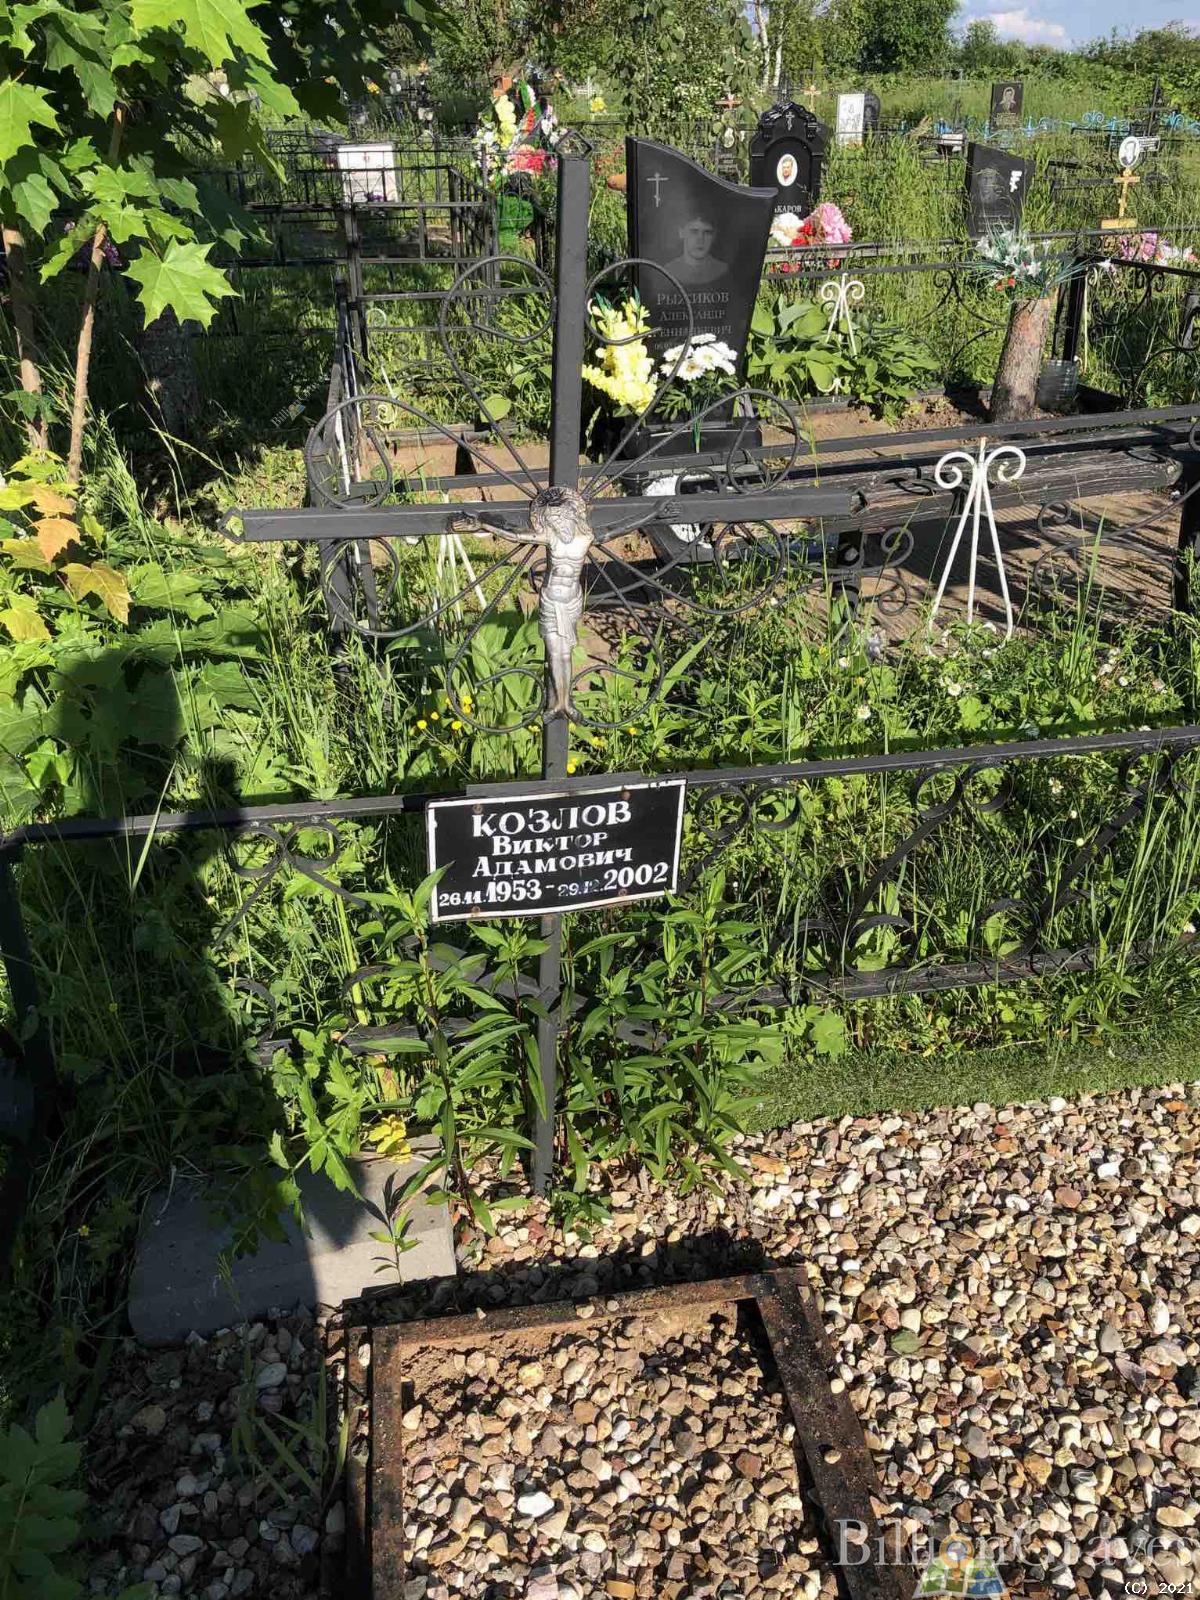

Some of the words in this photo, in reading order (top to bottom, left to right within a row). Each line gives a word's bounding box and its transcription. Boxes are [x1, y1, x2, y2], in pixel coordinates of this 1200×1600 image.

[774, 204, 802, 214] КАРОВ
[660, 309, 725, 321] АЛЕКАНДР
[471, 801, 632, 838] КОЗЛОВ
